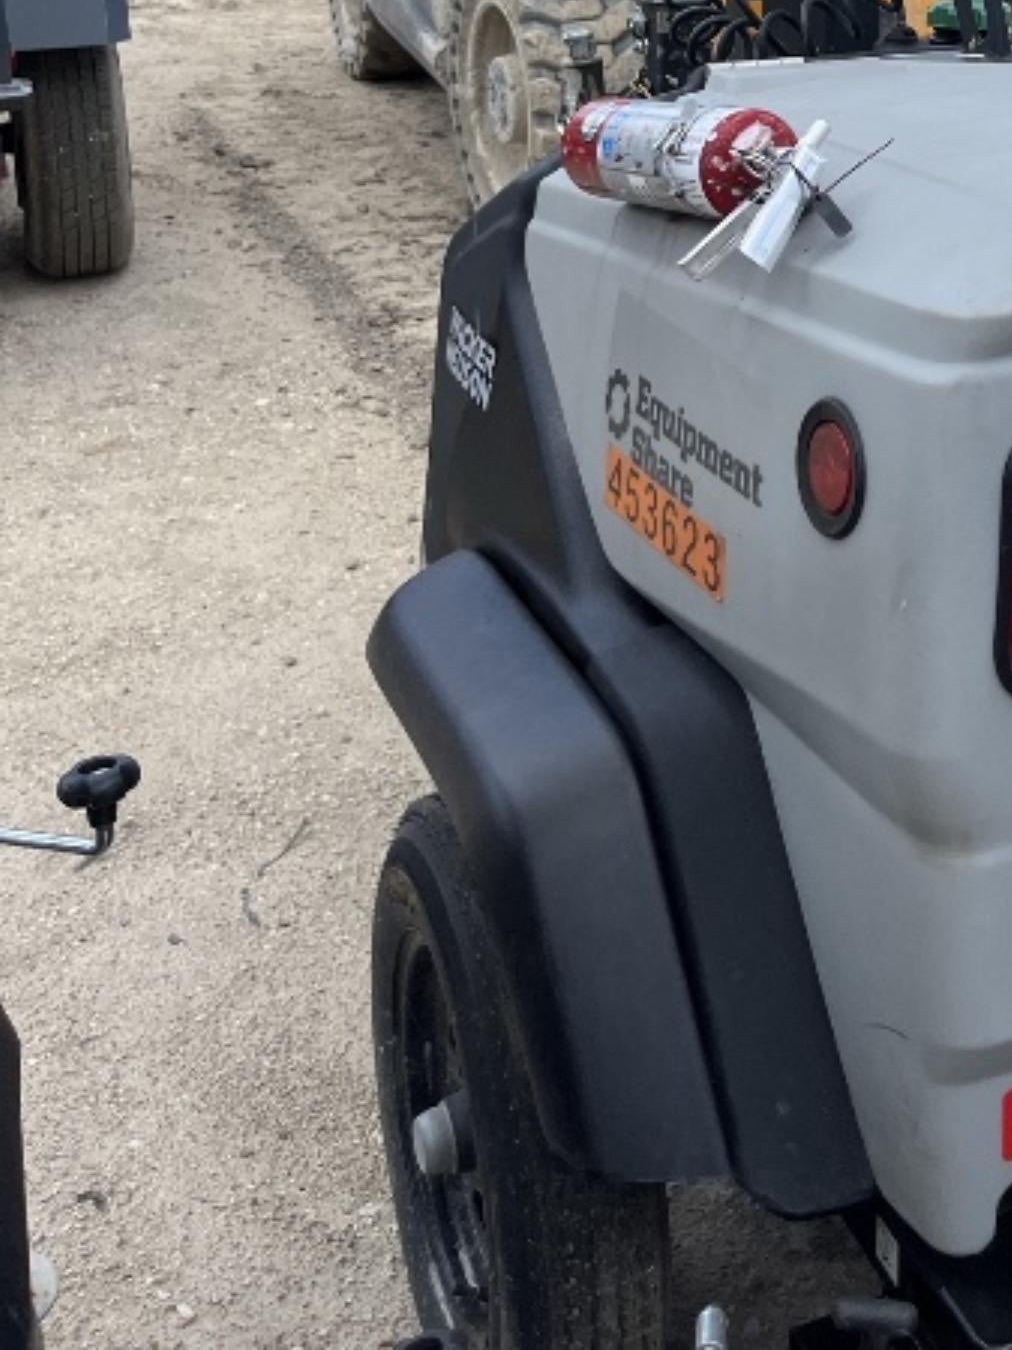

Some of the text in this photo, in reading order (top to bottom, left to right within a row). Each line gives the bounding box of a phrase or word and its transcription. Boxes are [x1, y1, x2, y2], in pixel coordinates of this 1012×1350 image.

[630, 425, 694, 508] Share
[636, 374, 763, 508] Equipment
[608, 457, 721, 592] 453623
